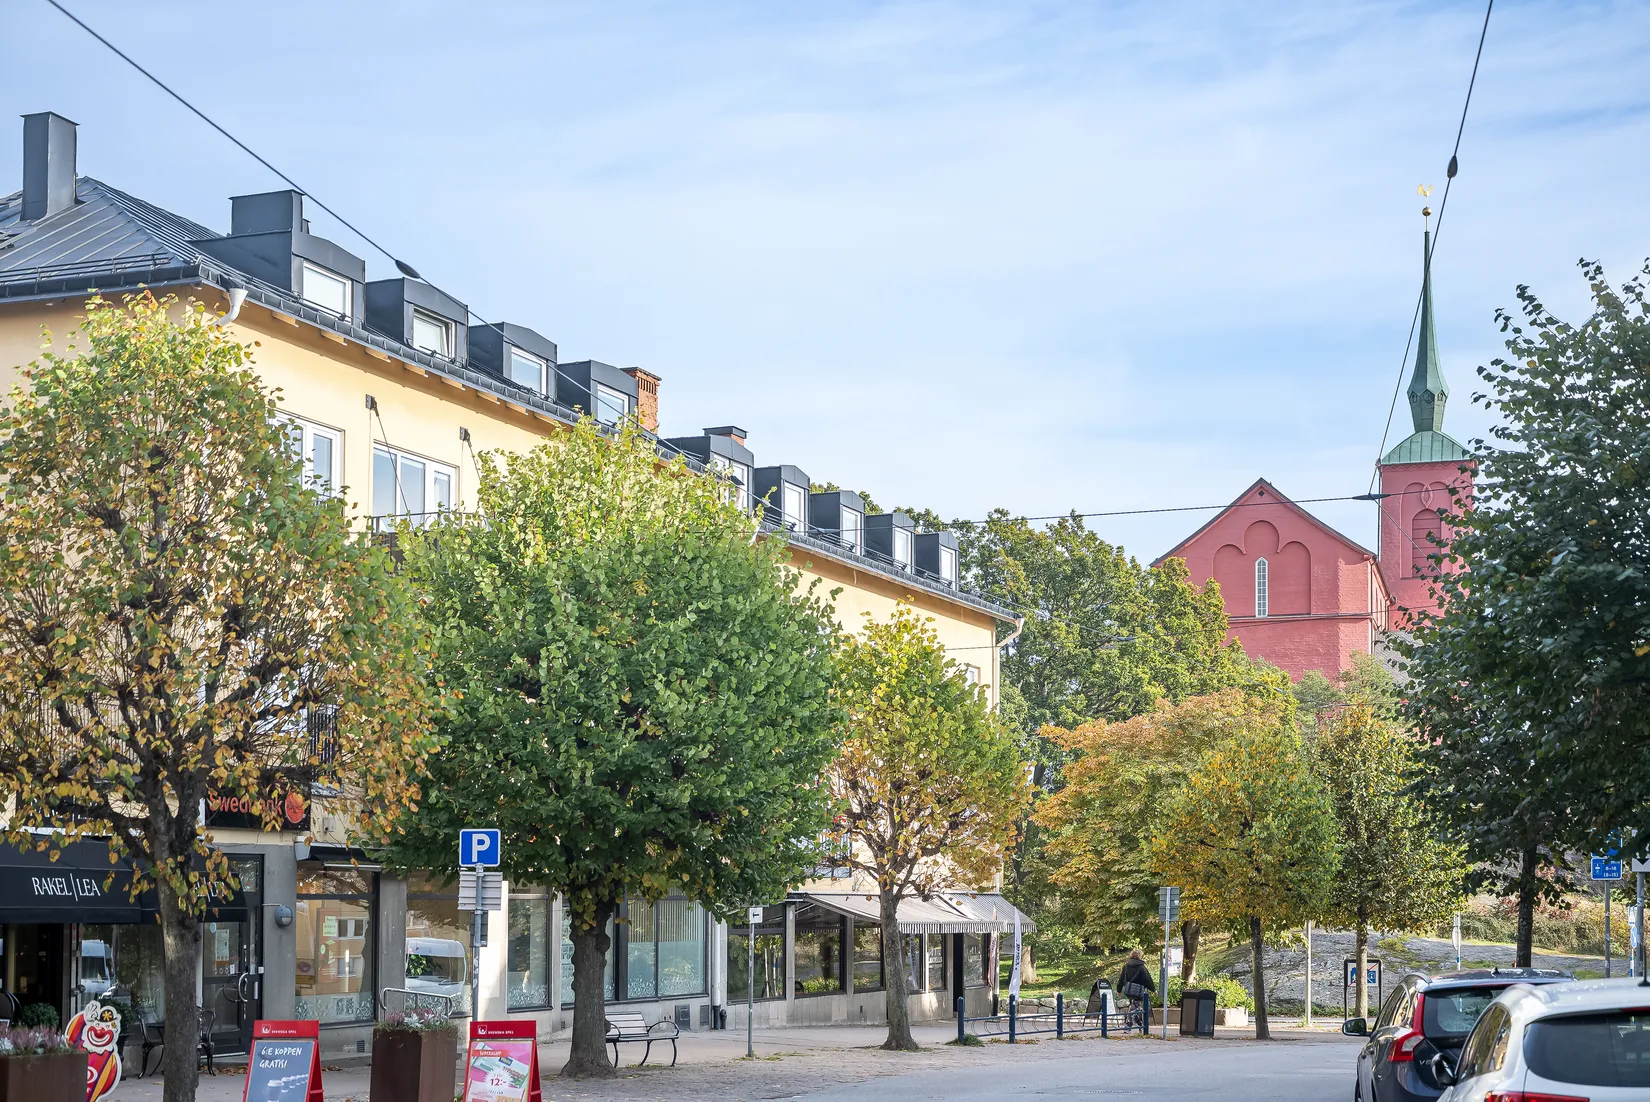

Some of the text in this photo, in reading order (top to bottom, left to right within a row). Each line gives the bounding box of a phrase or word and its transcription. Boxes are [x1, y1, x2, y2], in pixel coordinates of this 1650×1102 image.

[472, 833, 491, 862] P
[32, 877, 101, 896] RAKEL LEA
[274, 1047, 302, 1056] KOPPEN
[259, 1059, 288, 1069] GRATIS!
